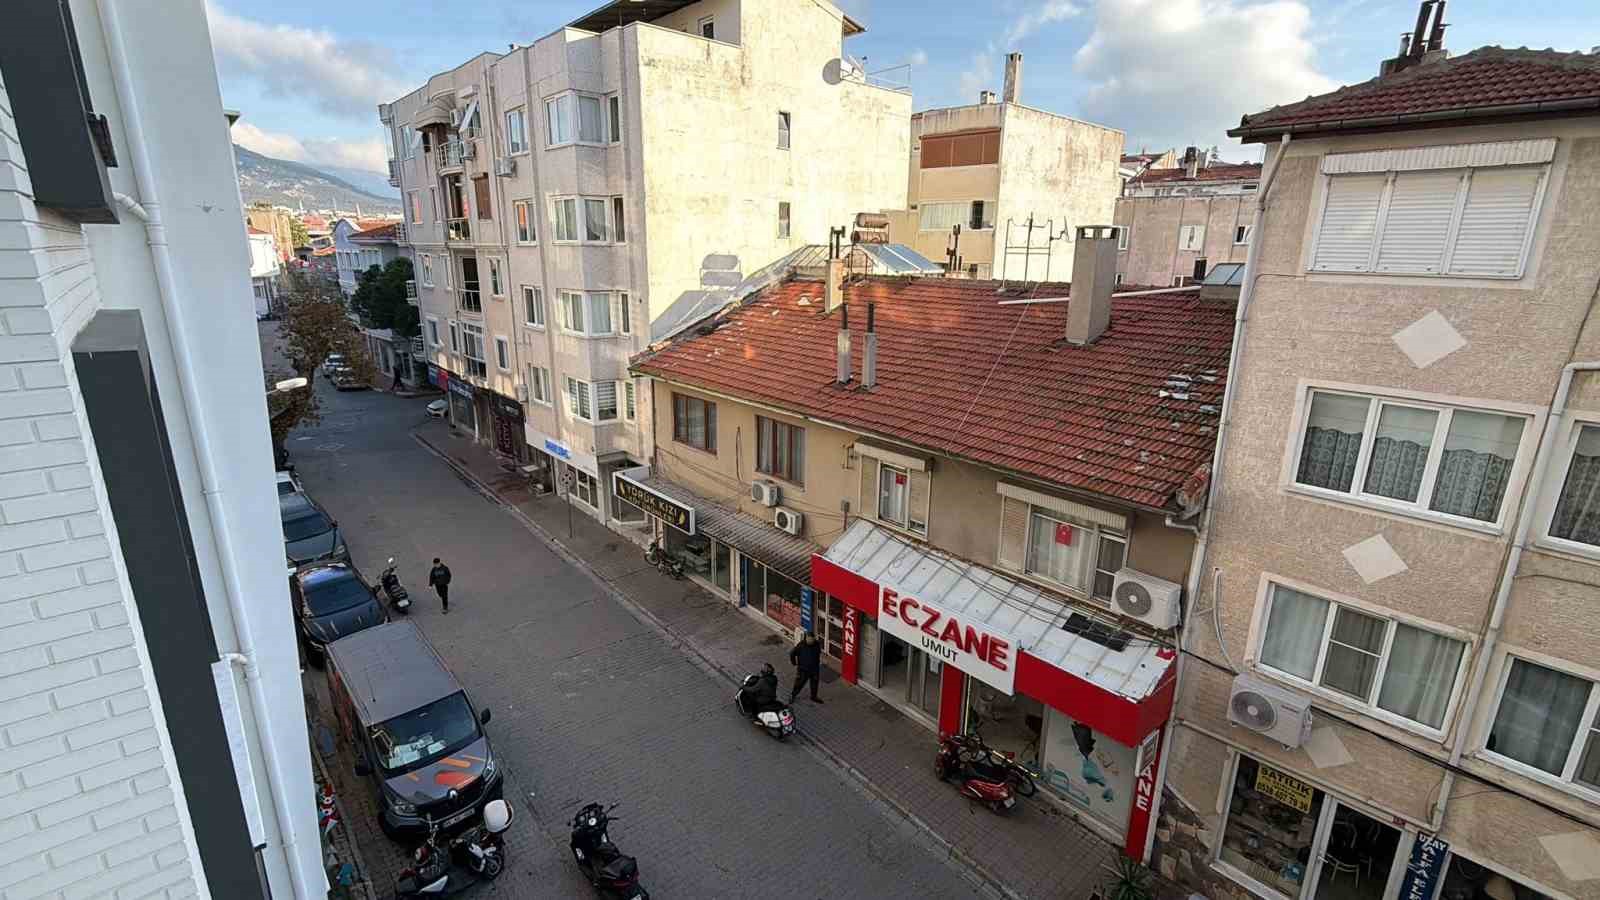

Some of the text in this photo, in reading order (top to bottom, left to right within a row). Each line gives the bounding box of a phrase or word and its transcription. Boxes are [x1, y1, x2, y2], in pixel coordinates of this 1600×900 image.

[882, 587, 1009, 671] ECZANE
[921, 636, 959, 662] UMUT
[1136, 762, 1155, 811] ANE
[1261, 767, 1311, 796] SATILIK
